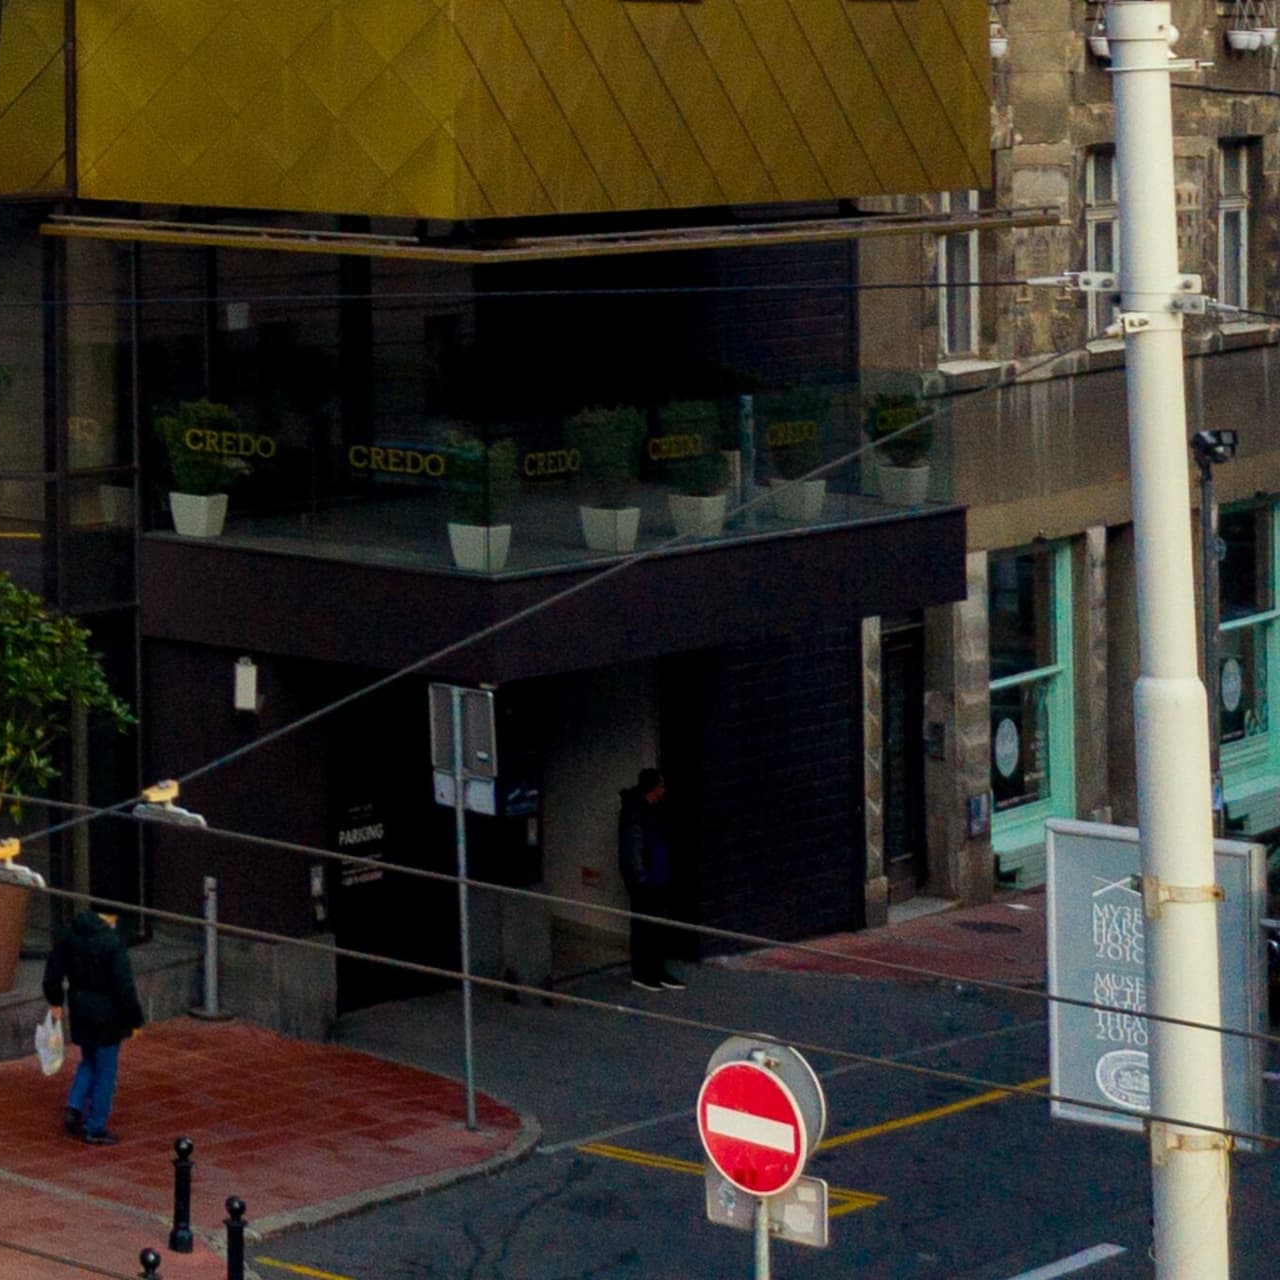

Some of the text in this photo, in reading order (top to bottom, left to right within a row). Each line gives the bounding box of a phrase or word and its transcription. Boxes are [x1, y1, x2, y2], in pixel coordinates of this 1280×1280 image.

[185, 428, 277, 459] CREDO
[348, 445, 445, 477] CREDO
[524, 448, 581, 477] CREDO
[339, 822, 384, 846] PARKING
